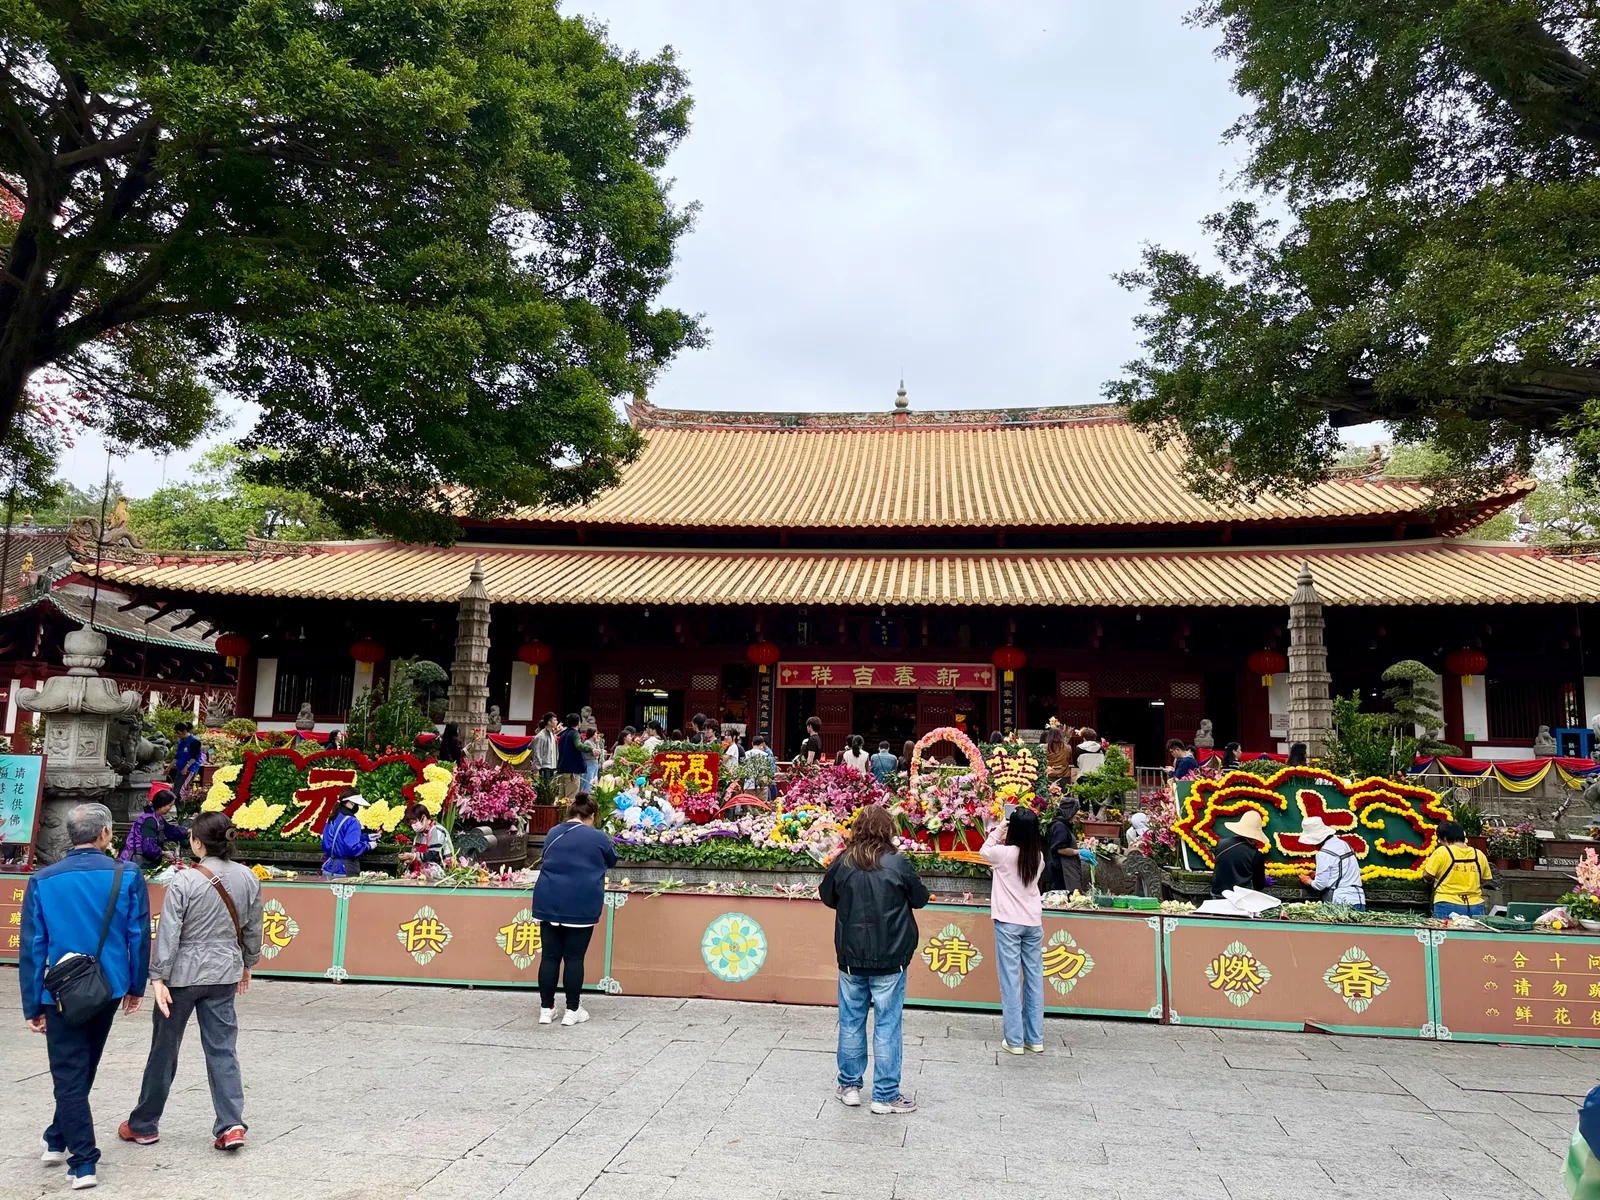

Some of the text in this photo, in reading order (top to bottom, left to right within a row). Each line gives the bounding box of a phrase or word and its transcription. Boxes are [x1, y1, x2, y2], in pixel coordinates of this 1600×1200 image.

[811, 665, 961, 688] 新春吉祥
[660, 754, 713, 793] 福
[9, 767, 26, 827] 请花供佛
[280, 767, 358, 838] 元
[12, 888, 25, 902] 问
